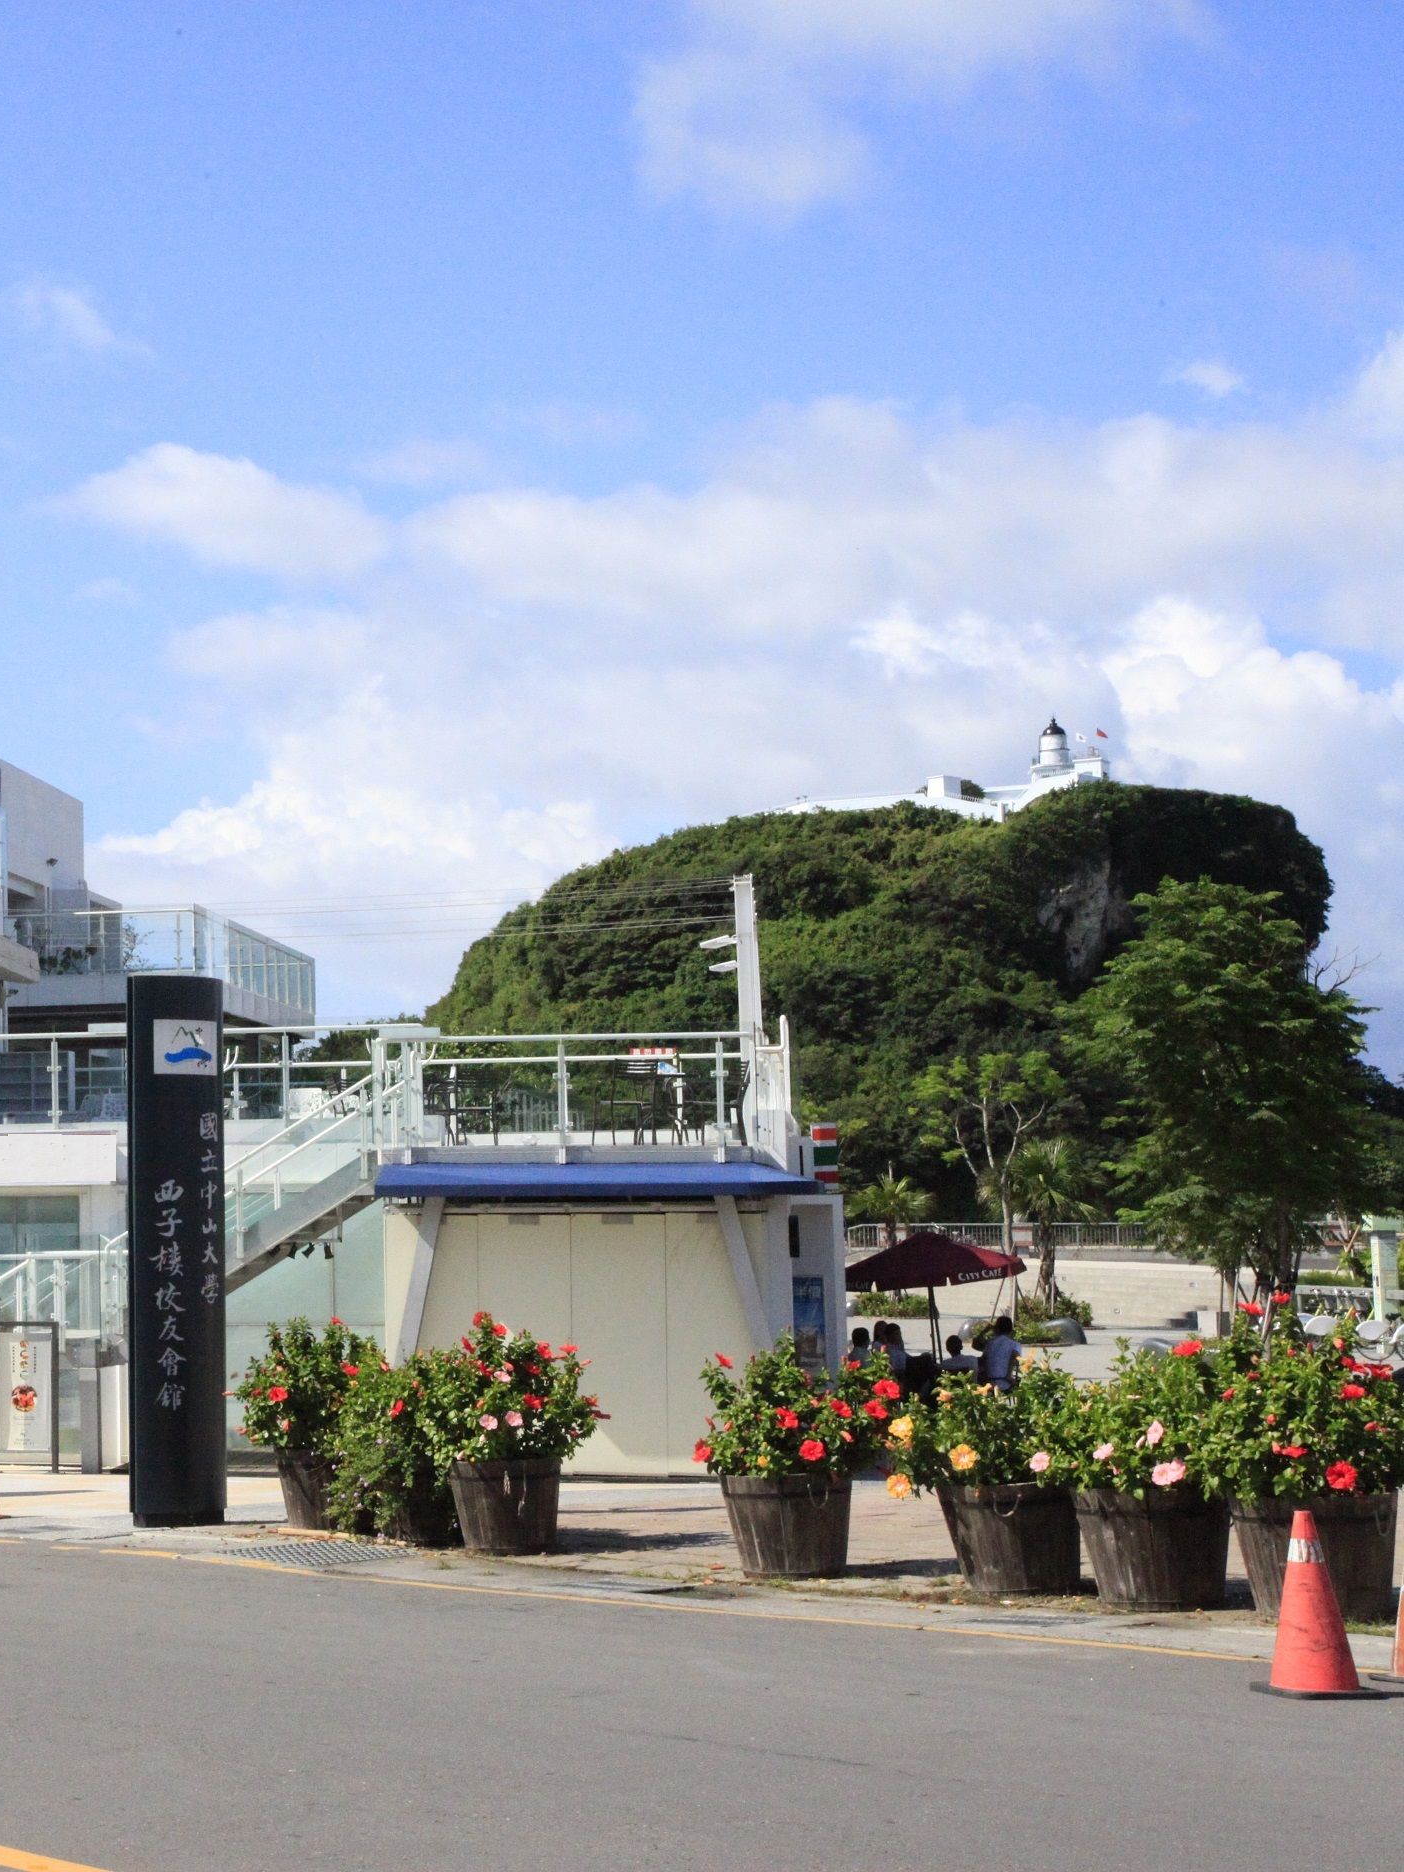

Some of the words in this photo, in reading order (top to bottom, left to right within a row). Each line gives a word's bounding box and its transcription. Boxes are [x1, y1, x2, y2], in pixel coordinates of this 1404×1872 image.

[199, 1112, 220, 1304] 國立中山大學
